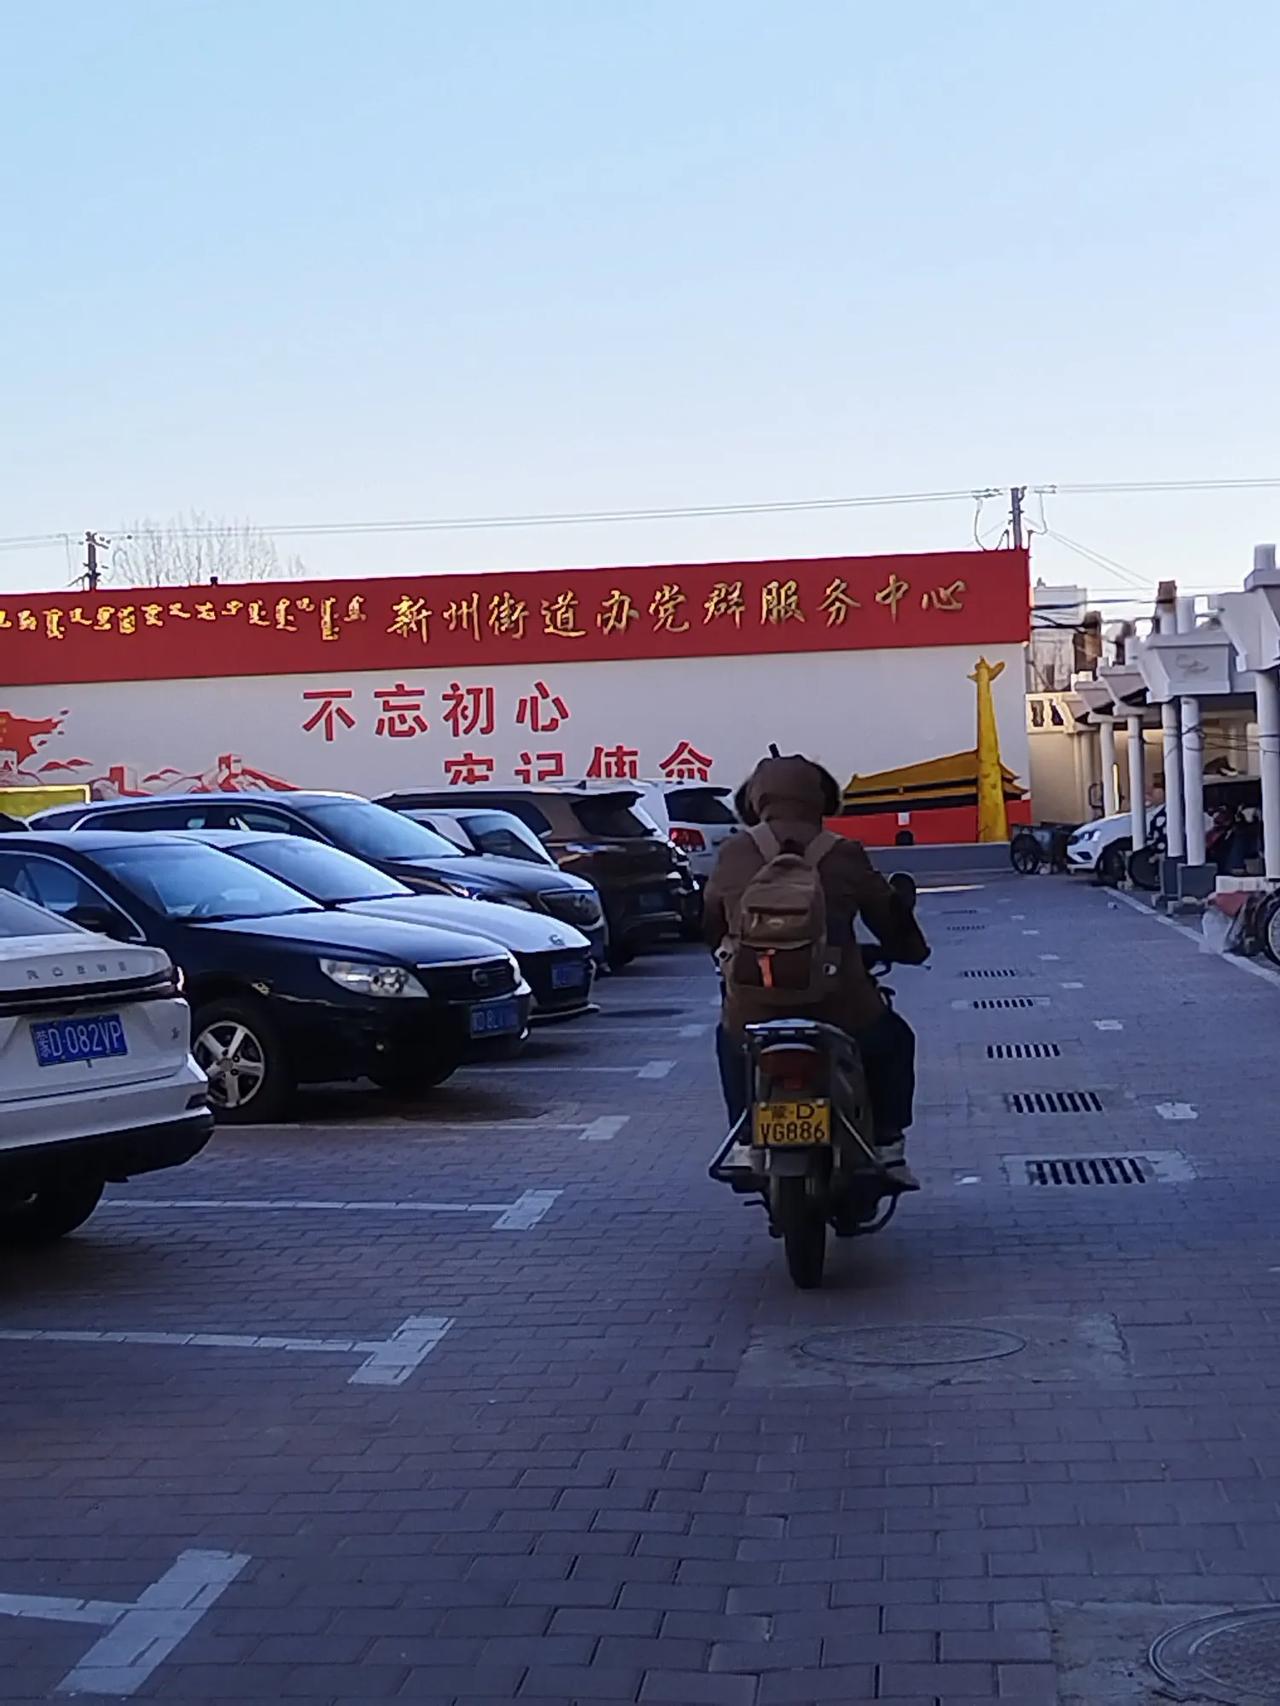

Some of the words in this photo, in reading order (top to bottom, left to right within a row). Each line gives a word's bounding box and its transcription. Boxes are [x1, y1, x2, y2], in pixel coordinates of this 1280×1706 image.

[387, 573, 966, 643] 新州街道办党群服务中心
[304, 682, 569, 740] 不忘初心
